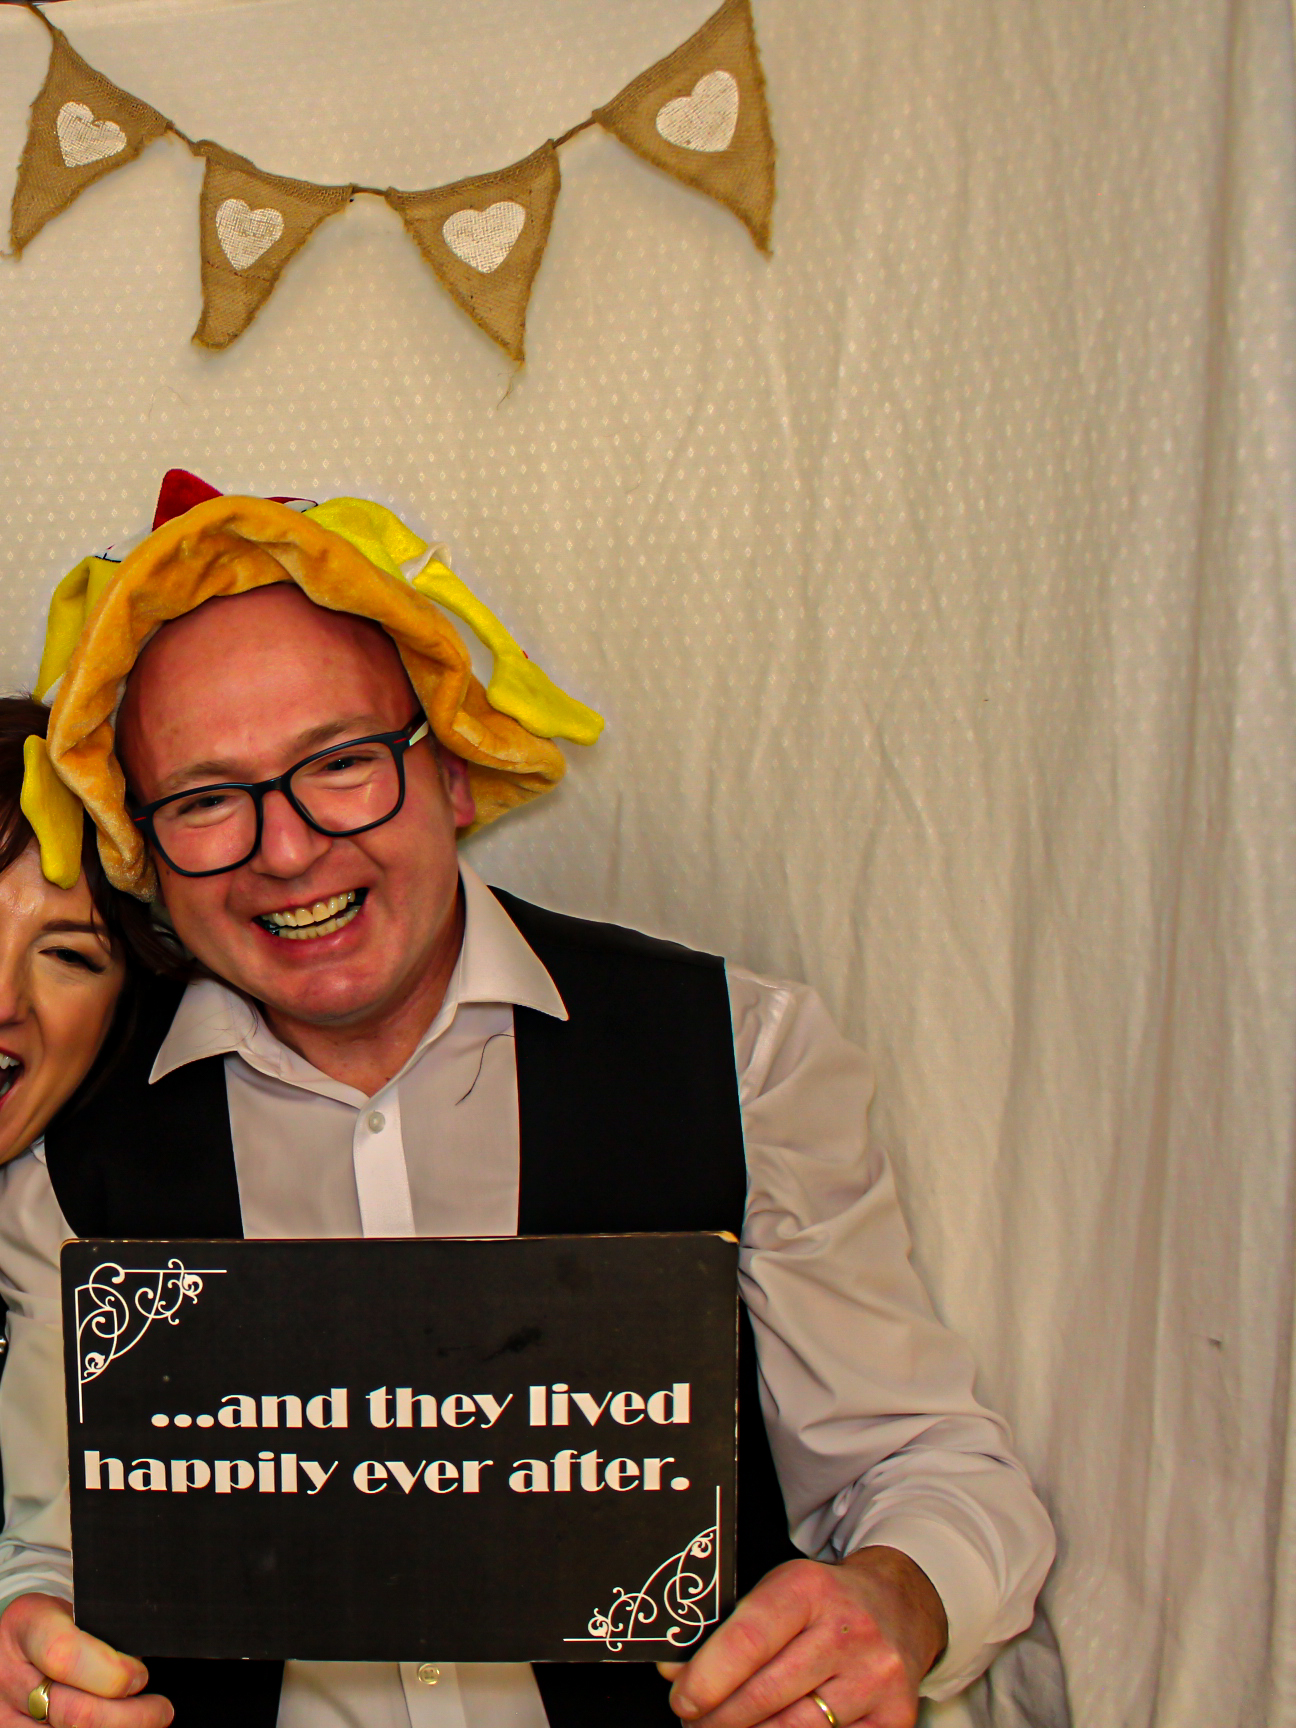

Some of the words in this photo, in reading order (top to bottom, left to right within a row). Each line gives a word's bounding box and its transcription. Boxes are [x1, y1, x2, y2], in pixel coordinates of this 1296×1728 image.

[151, 1386, 348, 1429] ...and
[365, 1385, 514, 1430] they
[529, 1382, 690, 1427] lived
[83, 1450, 339, 1496] happily
[352, 1459, 494, 1495] ever
[508, 1449, 690, 1493] after.
